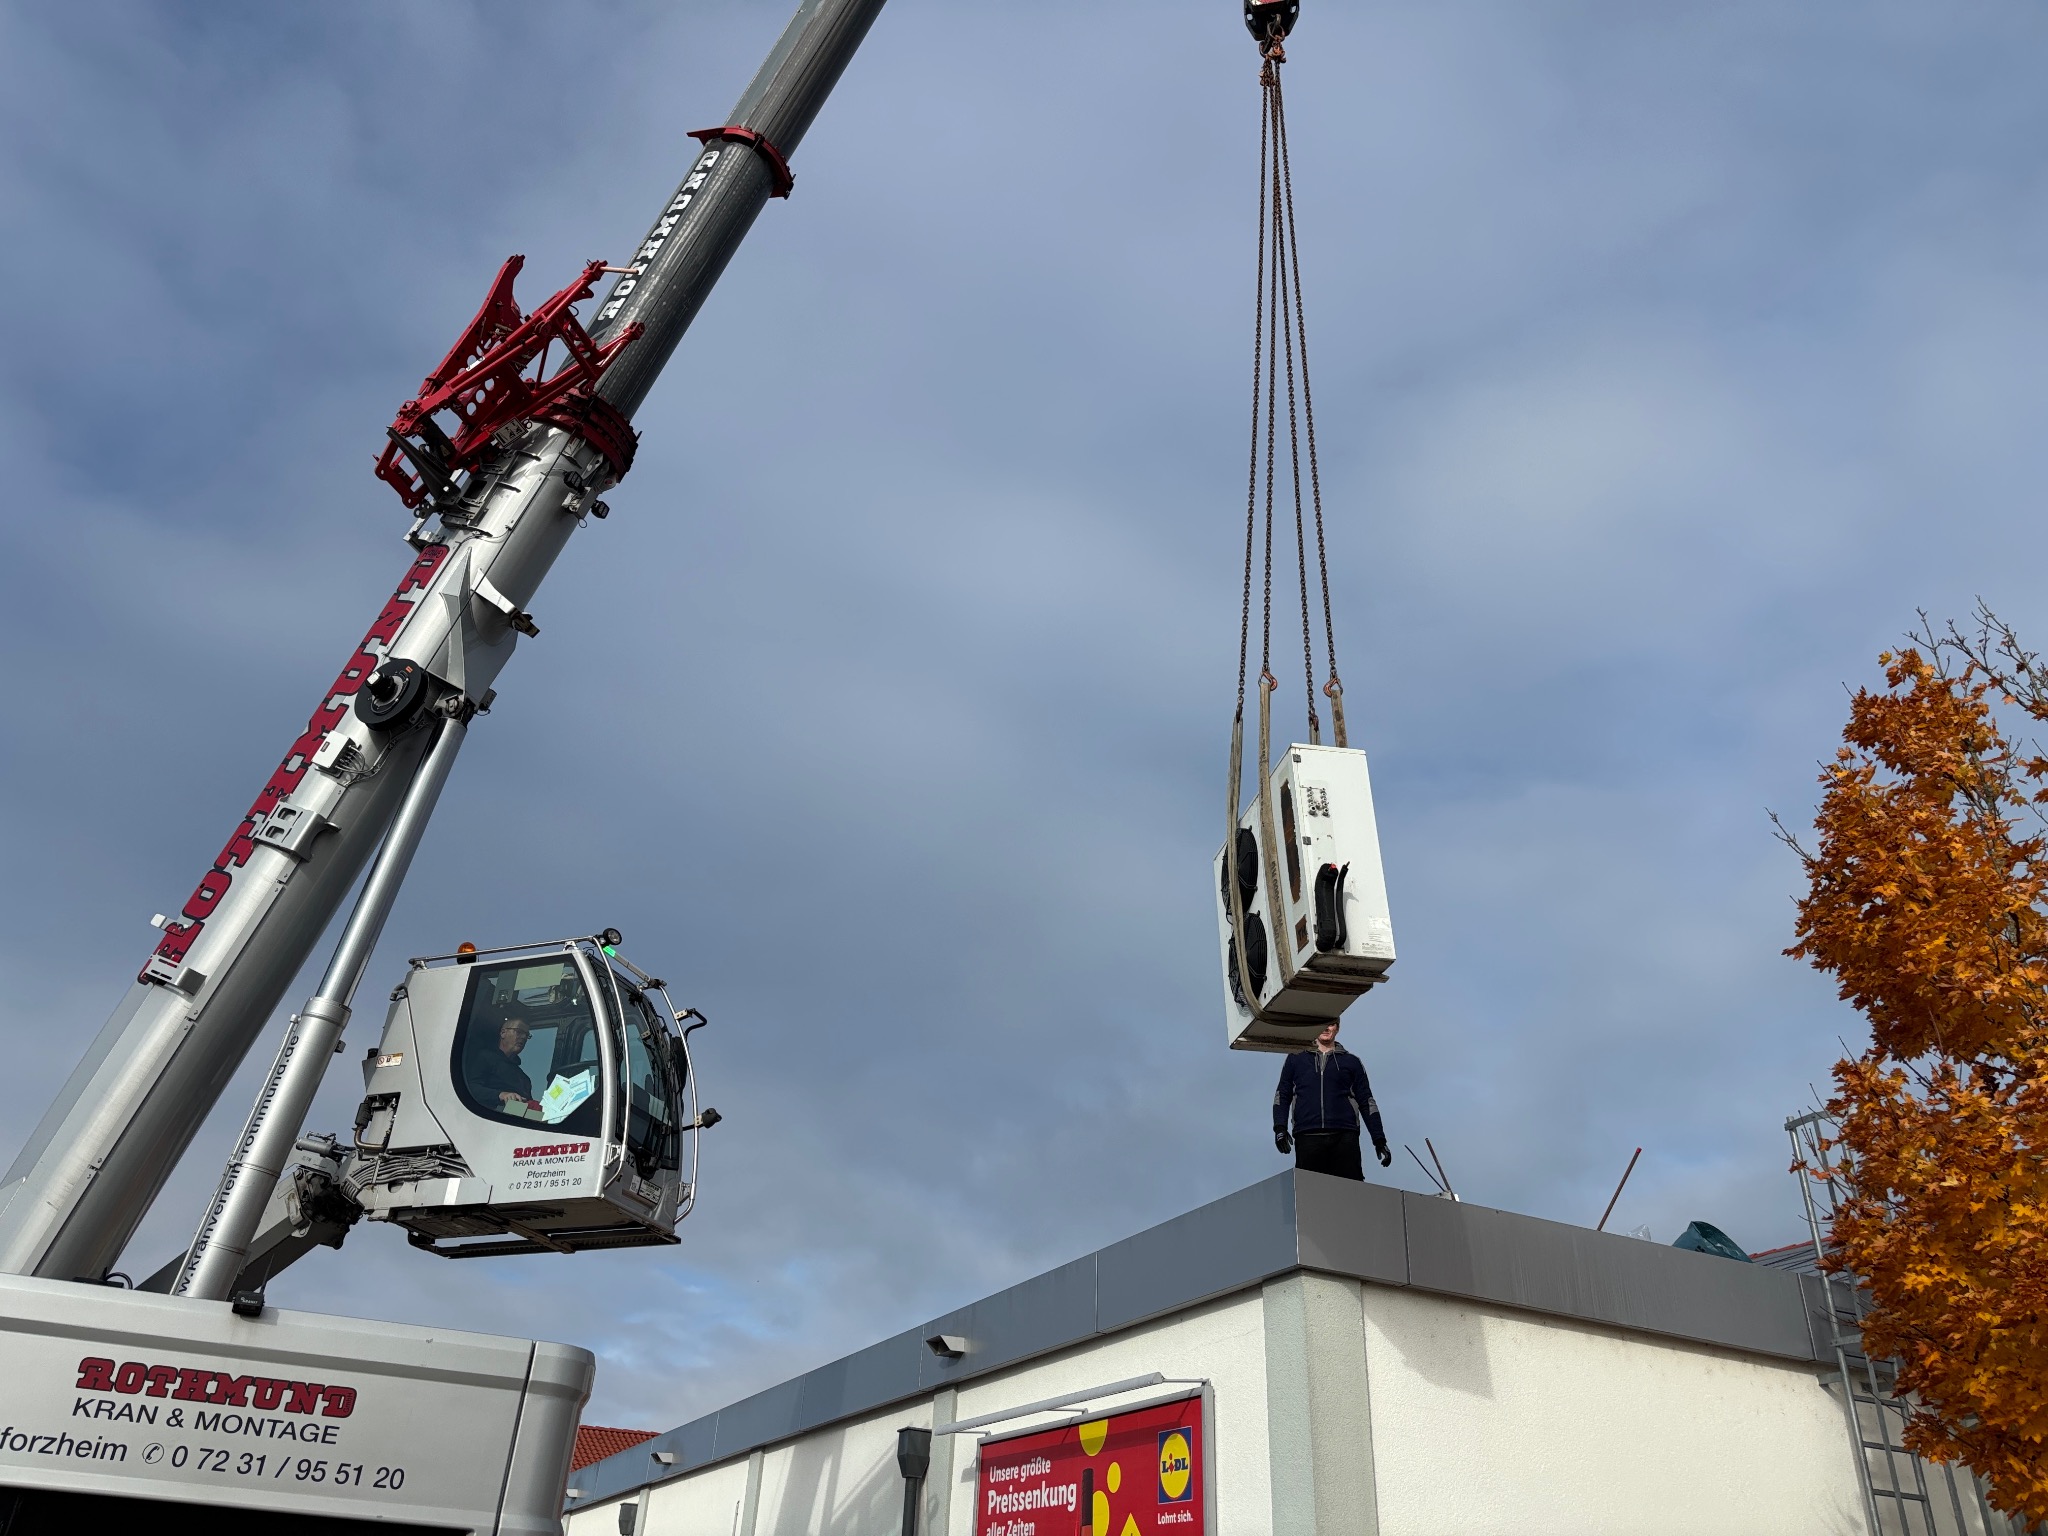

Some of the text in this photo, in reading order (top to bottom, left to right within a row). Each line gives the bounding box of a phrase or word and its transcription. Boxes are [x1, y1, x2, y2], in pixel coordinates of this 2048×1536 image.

[598, 151, 720, 321] ROTHMUND
[512, 1154, 587, 1168] KRAN & MONTAGE
[513, 1142, 591, 1159] ROTHMUND
[177, 1035, 299, 1297] w.kranverleih-rothmund.de
[526, 1168, 566, 1179] Pforzheim
[515, 1177, 582, 1190] 0 72 31 / 95 51 20
[75, 1356, 358, 1419] ROTHMUND
[72, 1397, 340, 1445] KRAN & MONTAGE
[0, 1426, 405, 1490] forzheim 0 72 31 / 95 51 20
[989, 1456, 1051, 1484] Unsere größte
[987, 1480, 1077, 1516] Preissenkung
[986, 1517, 1035, 1536] aller Zeiten
[1157, 1509, 1194, 1525] Lohnt sich.
